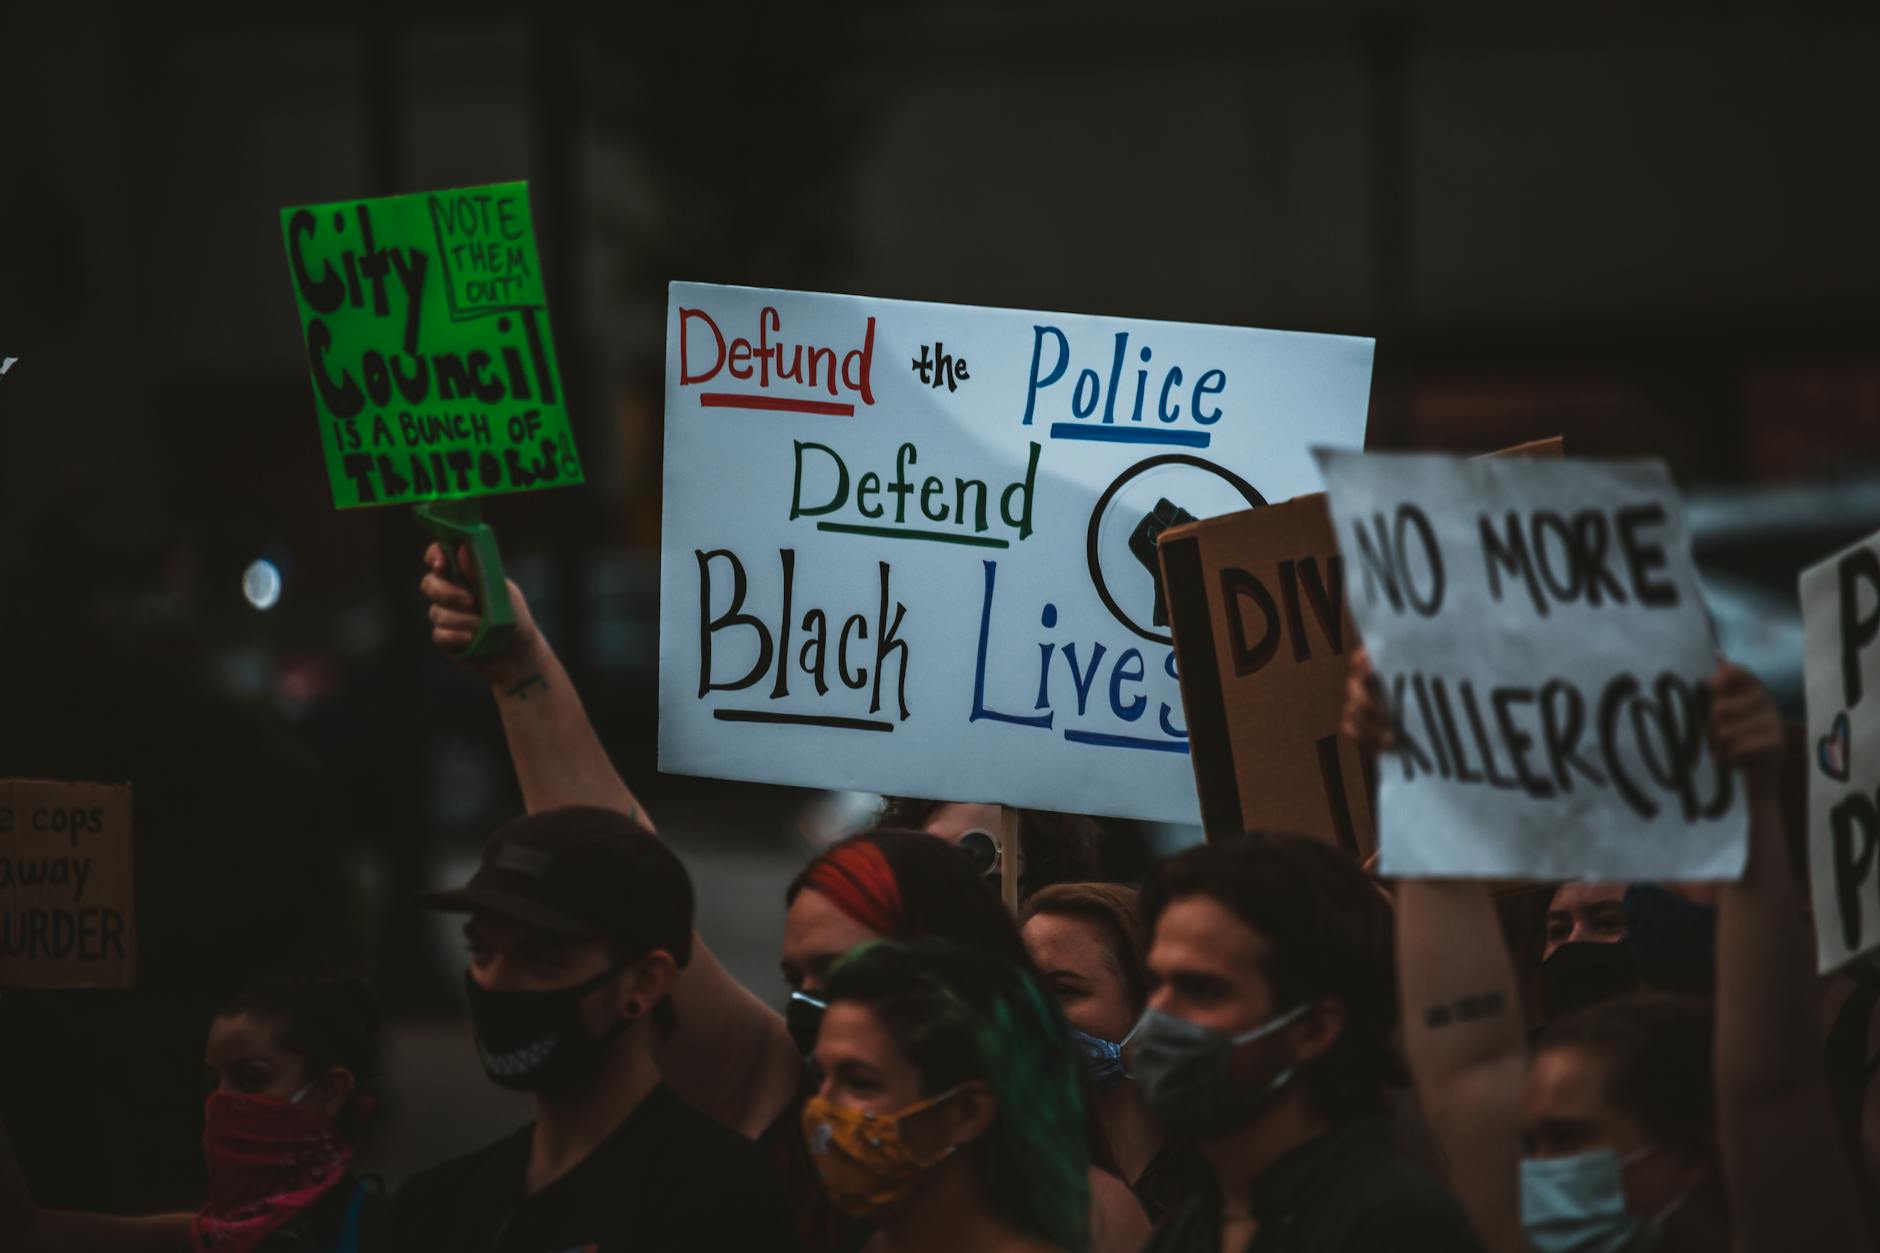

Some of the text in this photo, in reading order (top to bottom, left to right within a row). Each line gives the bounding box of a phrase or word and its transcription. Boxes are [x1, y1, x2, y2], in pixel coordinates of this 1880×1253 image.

[429, 195, 525, 240] VOTE
[450, 241, 531, 278] THEM
[289, 204, 428, 354] City
[307, 307, 557, 418] Council
[678, 306, 1226, 425] Defund the Police
[333, 408, 542, 450] IS A BUNCH OF
[789, 439, 1043, 541] Defend
[1353, 502, 1681, 618] NO MORE
[694, 548, 911, 721] Black
[32, 806, 104, 848] cops
[0, 906, 126, 961] URDER
